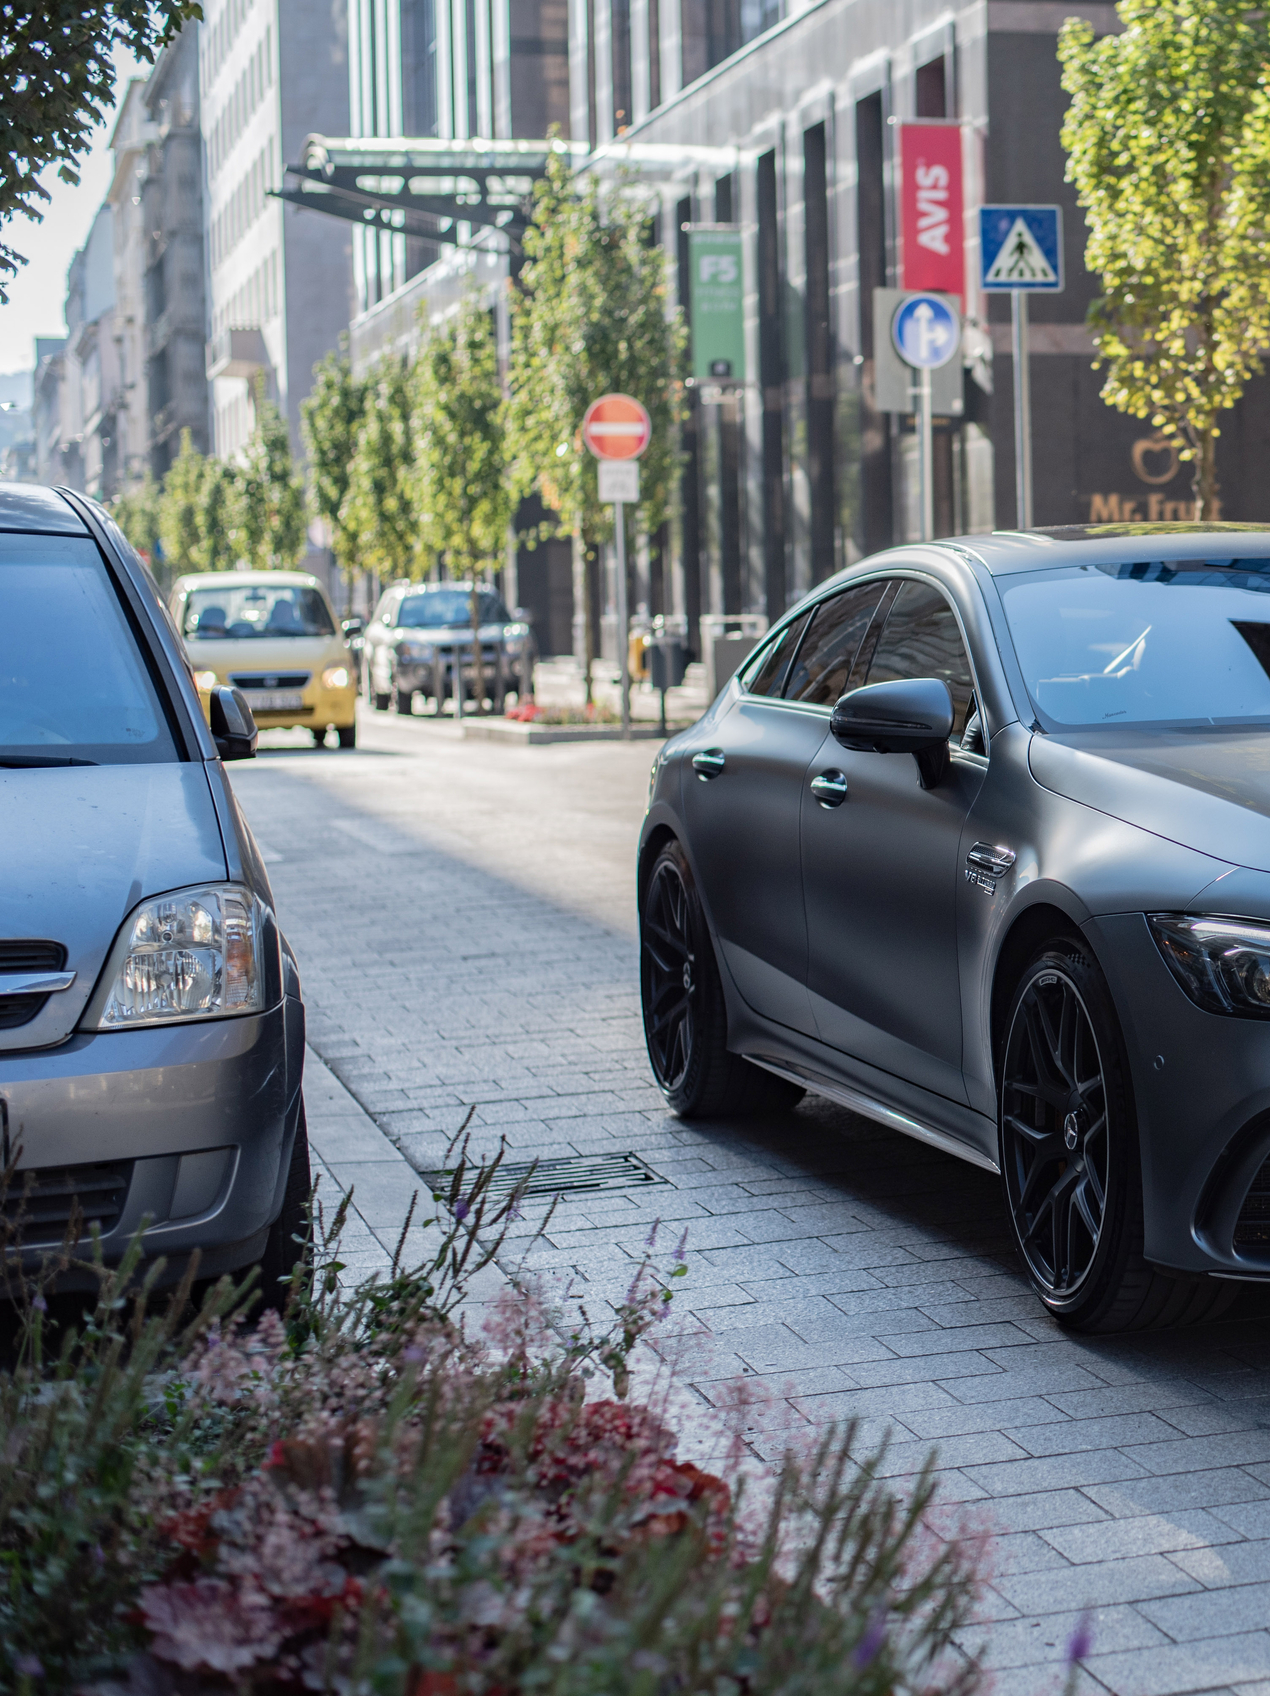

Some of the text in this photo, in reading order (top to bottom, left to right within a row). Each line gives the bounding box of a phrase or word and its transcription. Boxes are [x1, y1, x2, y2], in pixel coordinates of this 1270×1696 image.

[916, 164, 950, 255] AVIS
[700, 254, 739, 284] F5
[1089, 493, 1223, 522] Mr. Frut
